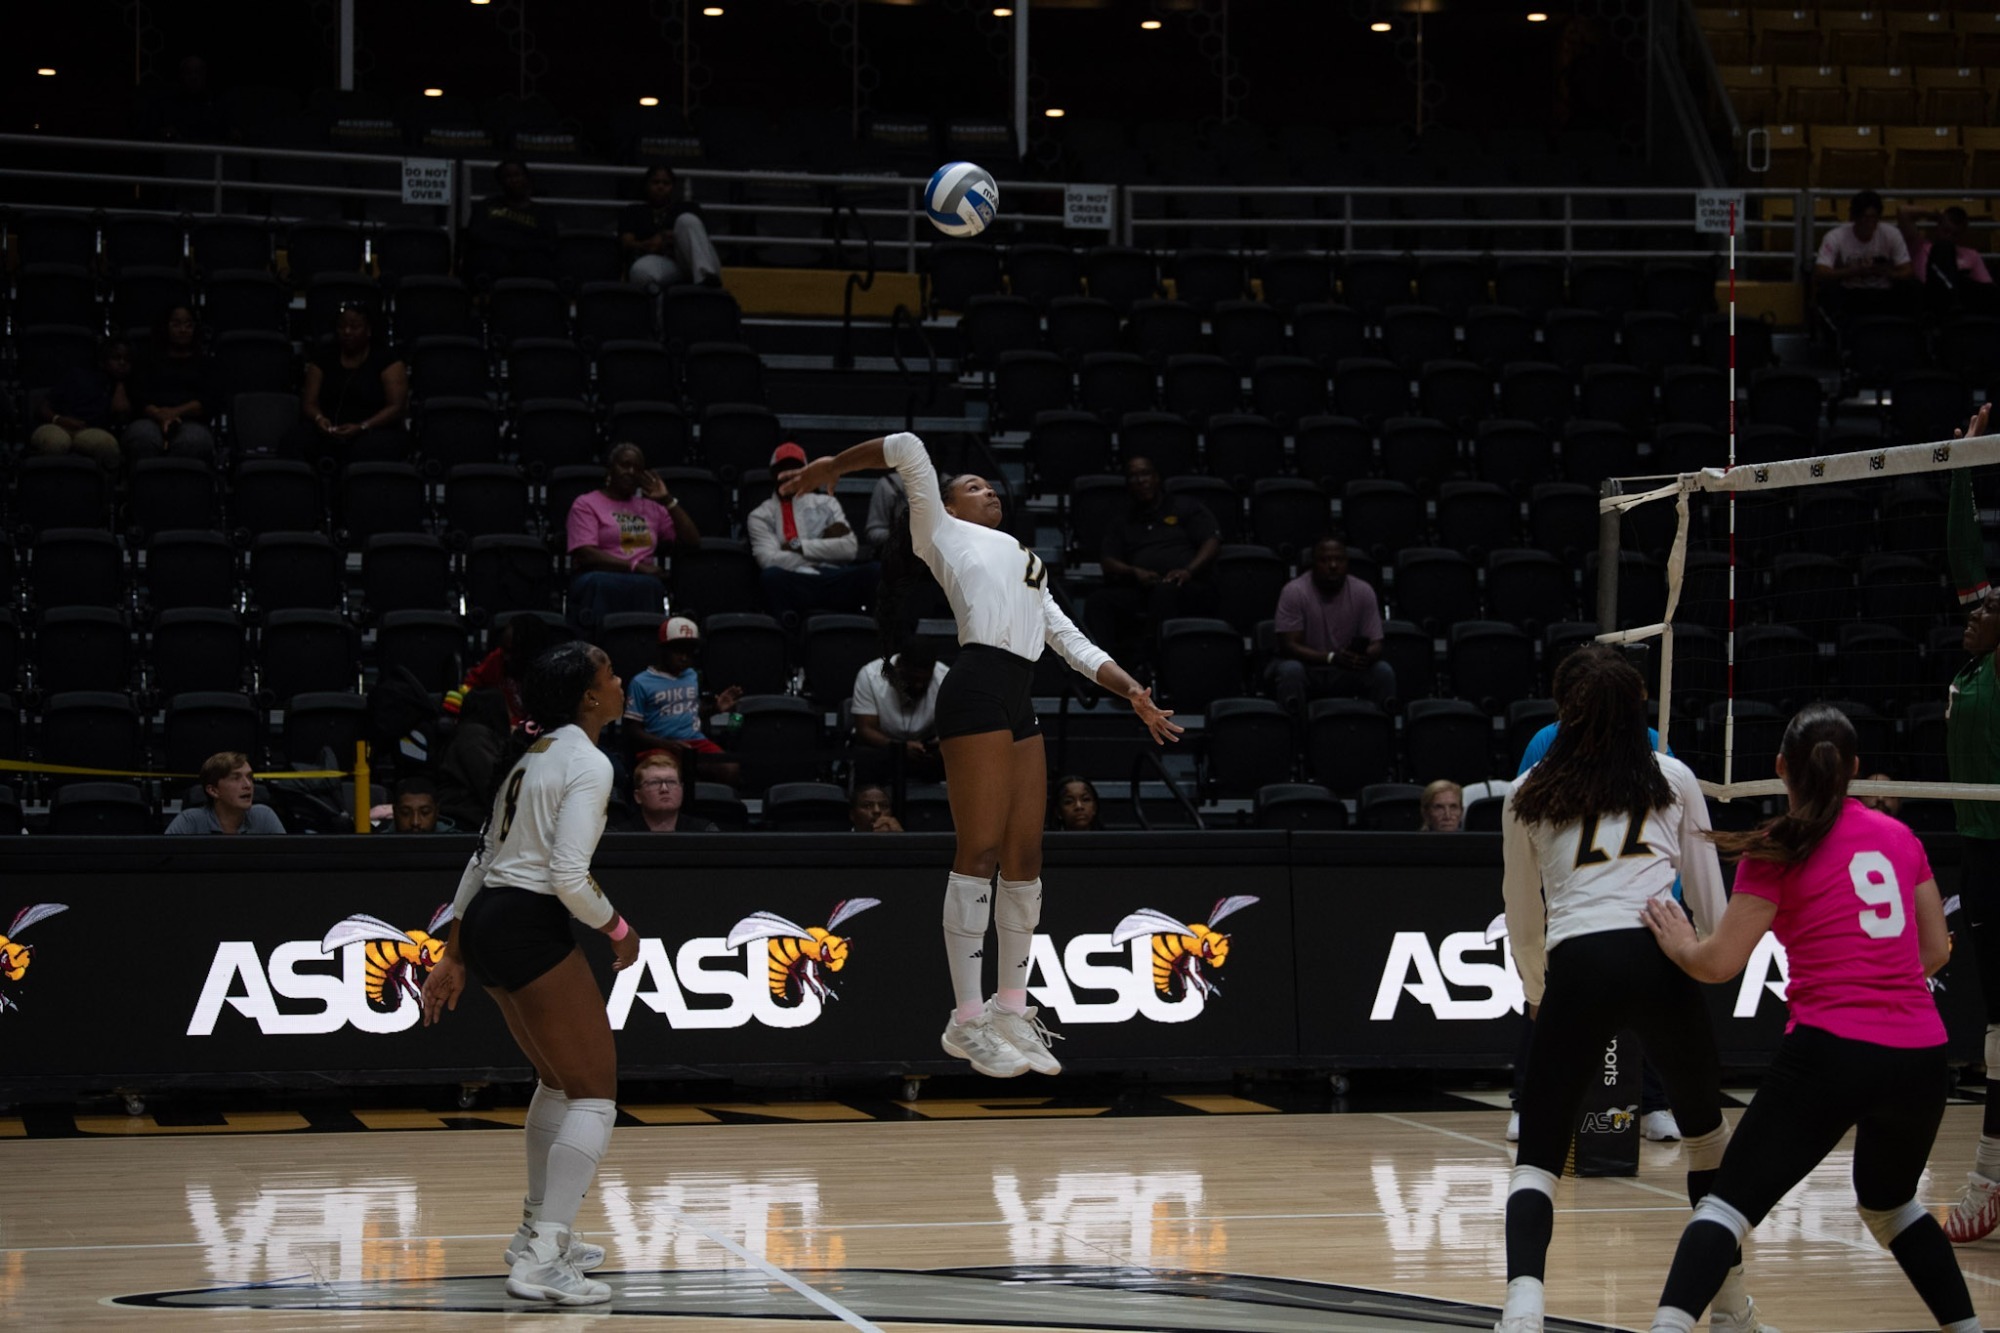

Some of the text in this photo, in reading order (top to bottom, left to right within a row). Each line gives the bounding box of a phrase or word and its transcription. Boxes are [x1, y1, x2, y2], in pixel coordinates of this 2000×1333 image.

[405, 168, 448, 178] DO NOT
[408, 179, 446, 188] CROSS
[411, 190, 443, 200] OVER
[1067, 193, 1108, 203] DO NOT
[1699, 198, 1714, 207] DO
[1070, 204, 1106, 213] CROSS
[1072, 215, 1103, 224] OVER
[654, 686, 697, 705] PIKE
[1848, 850, 1906, 940] 9
[1369, 931, 1525, 1019] AS
[186, 938, 421, 1036] ASU
[606, 936, 824, 1030] ASU
[1580, 1112, 1630, 1134] ASU
